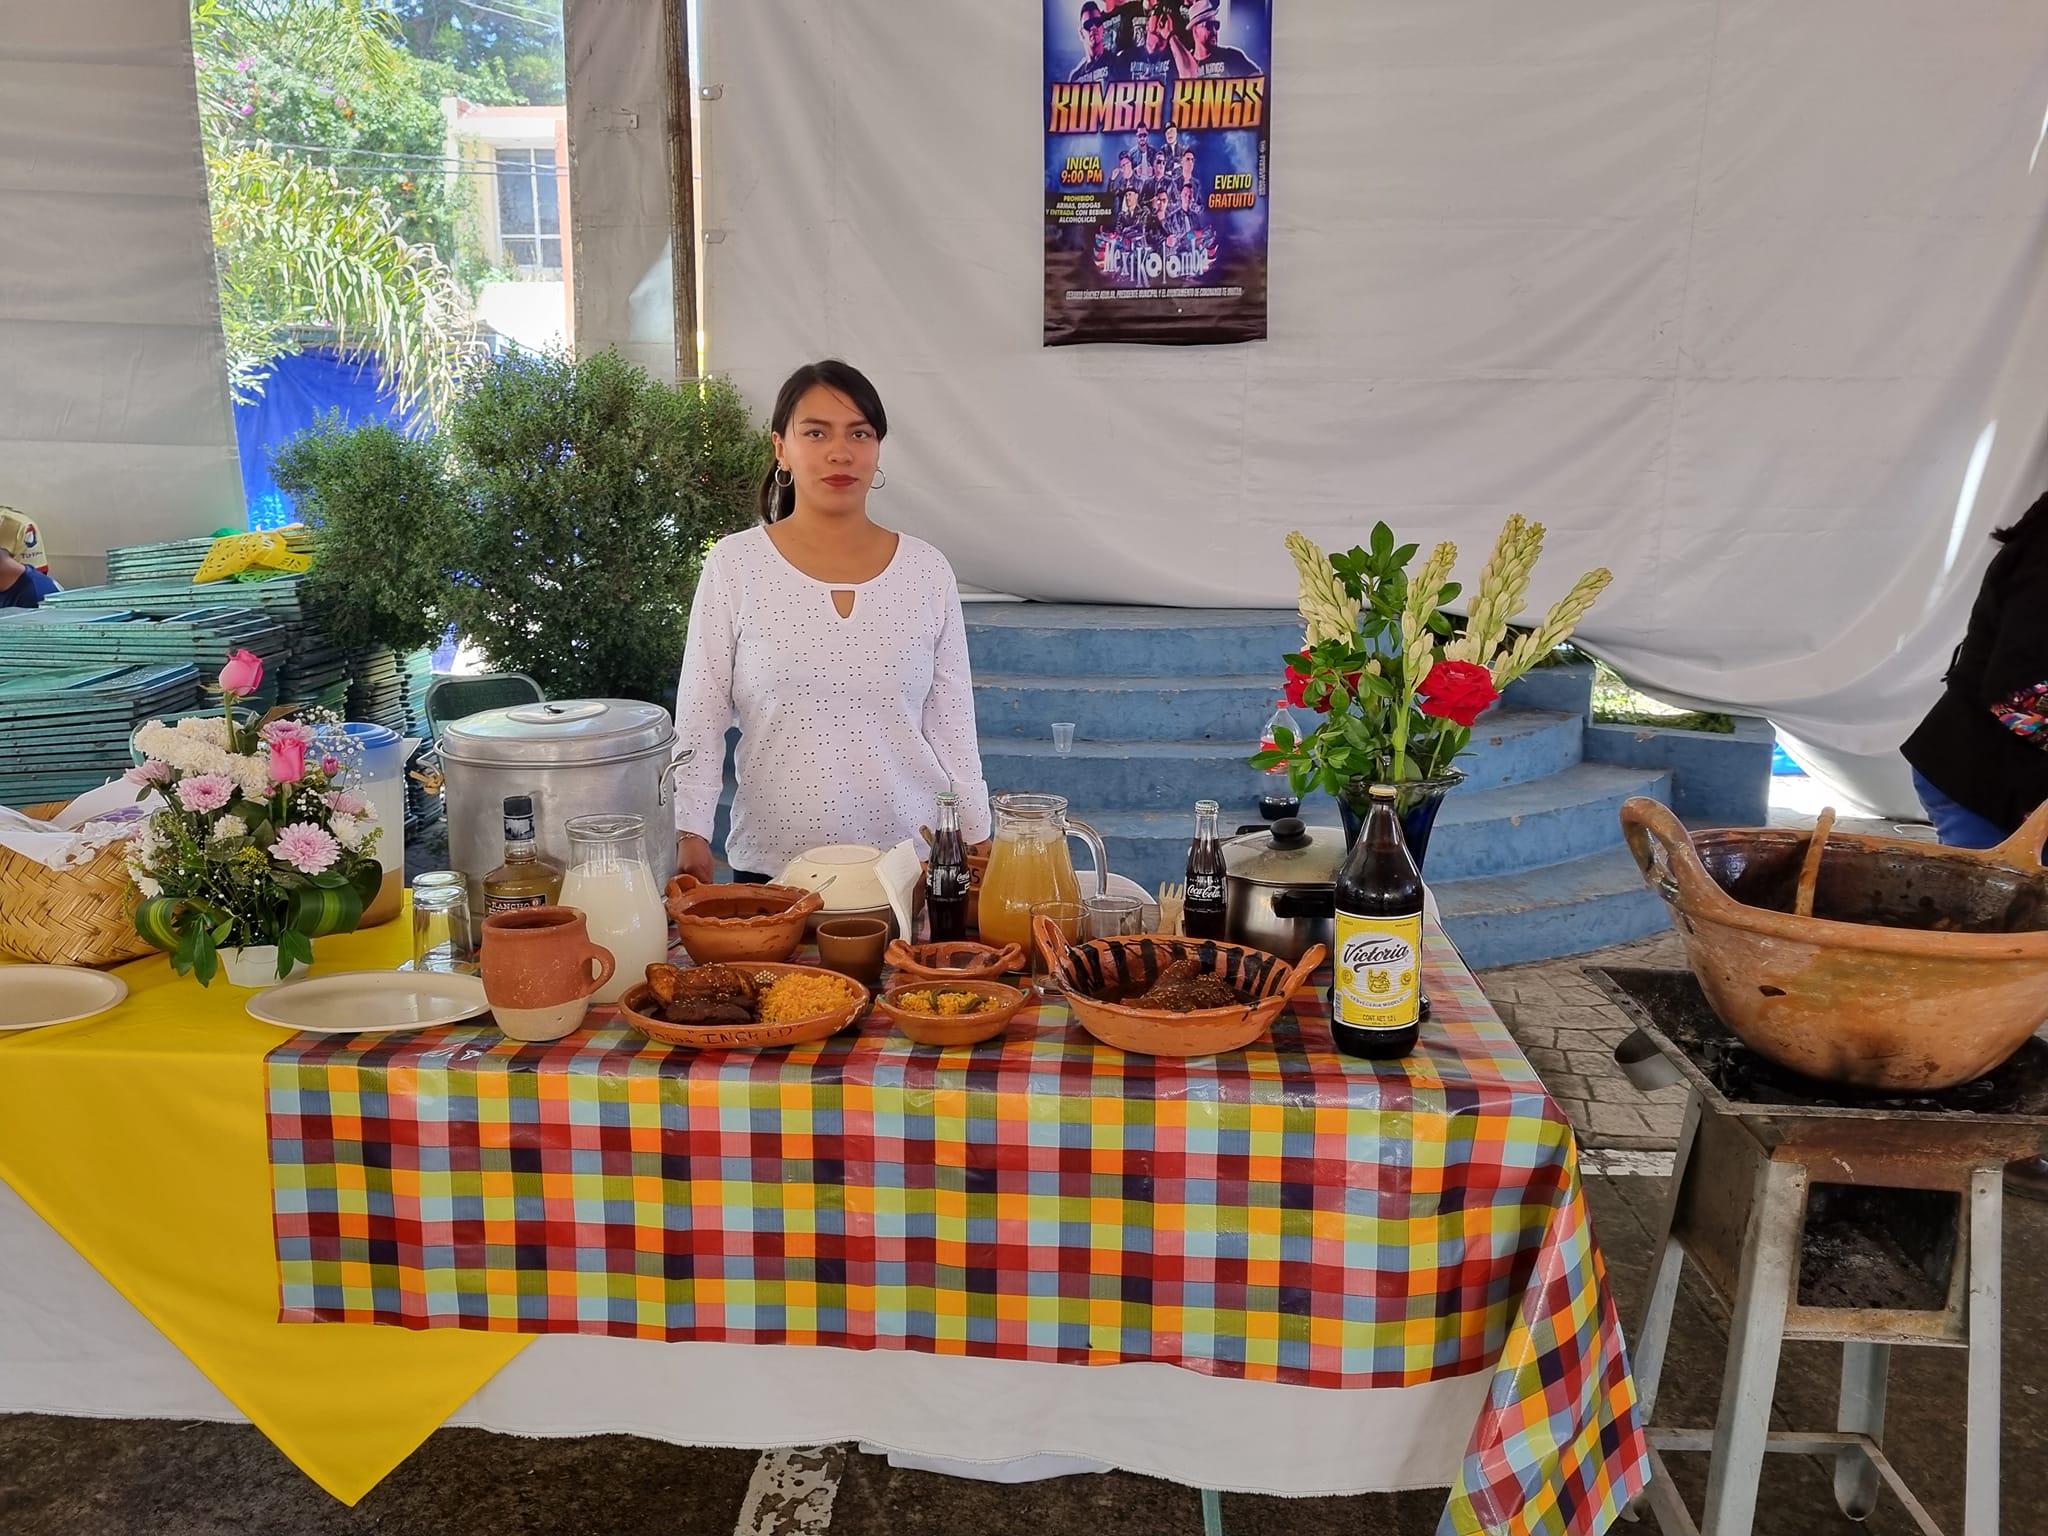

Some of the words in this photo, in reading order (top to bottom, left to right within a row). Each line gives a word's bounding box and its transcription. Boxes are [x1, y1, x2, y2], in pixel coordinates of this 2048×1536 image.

[1048, 81, 1165, 133] KUMBIA
[1172, 77, 1265, 130] KINGS
[1066, 156, 1100, 170] INICIA
[1061, 169, 1084, 183] 9:00
[1086, 169, 1103, 183] PM
[1214, 173, 1252, 190] EVENTO
[1063, 194, 1095, 202] PROHIBIDO
[1208, 192, 1256, 209] GRATUITO
[1050, 208, 1075, 216] ENTRADA
[1088, 208, 1112, 216] BEBIDAS
[1186, 884, 1222, 899] Coca-Cola
[491, 901, 530, 910] RANCHO
[1343, 938, 1410, 973] Victoria
